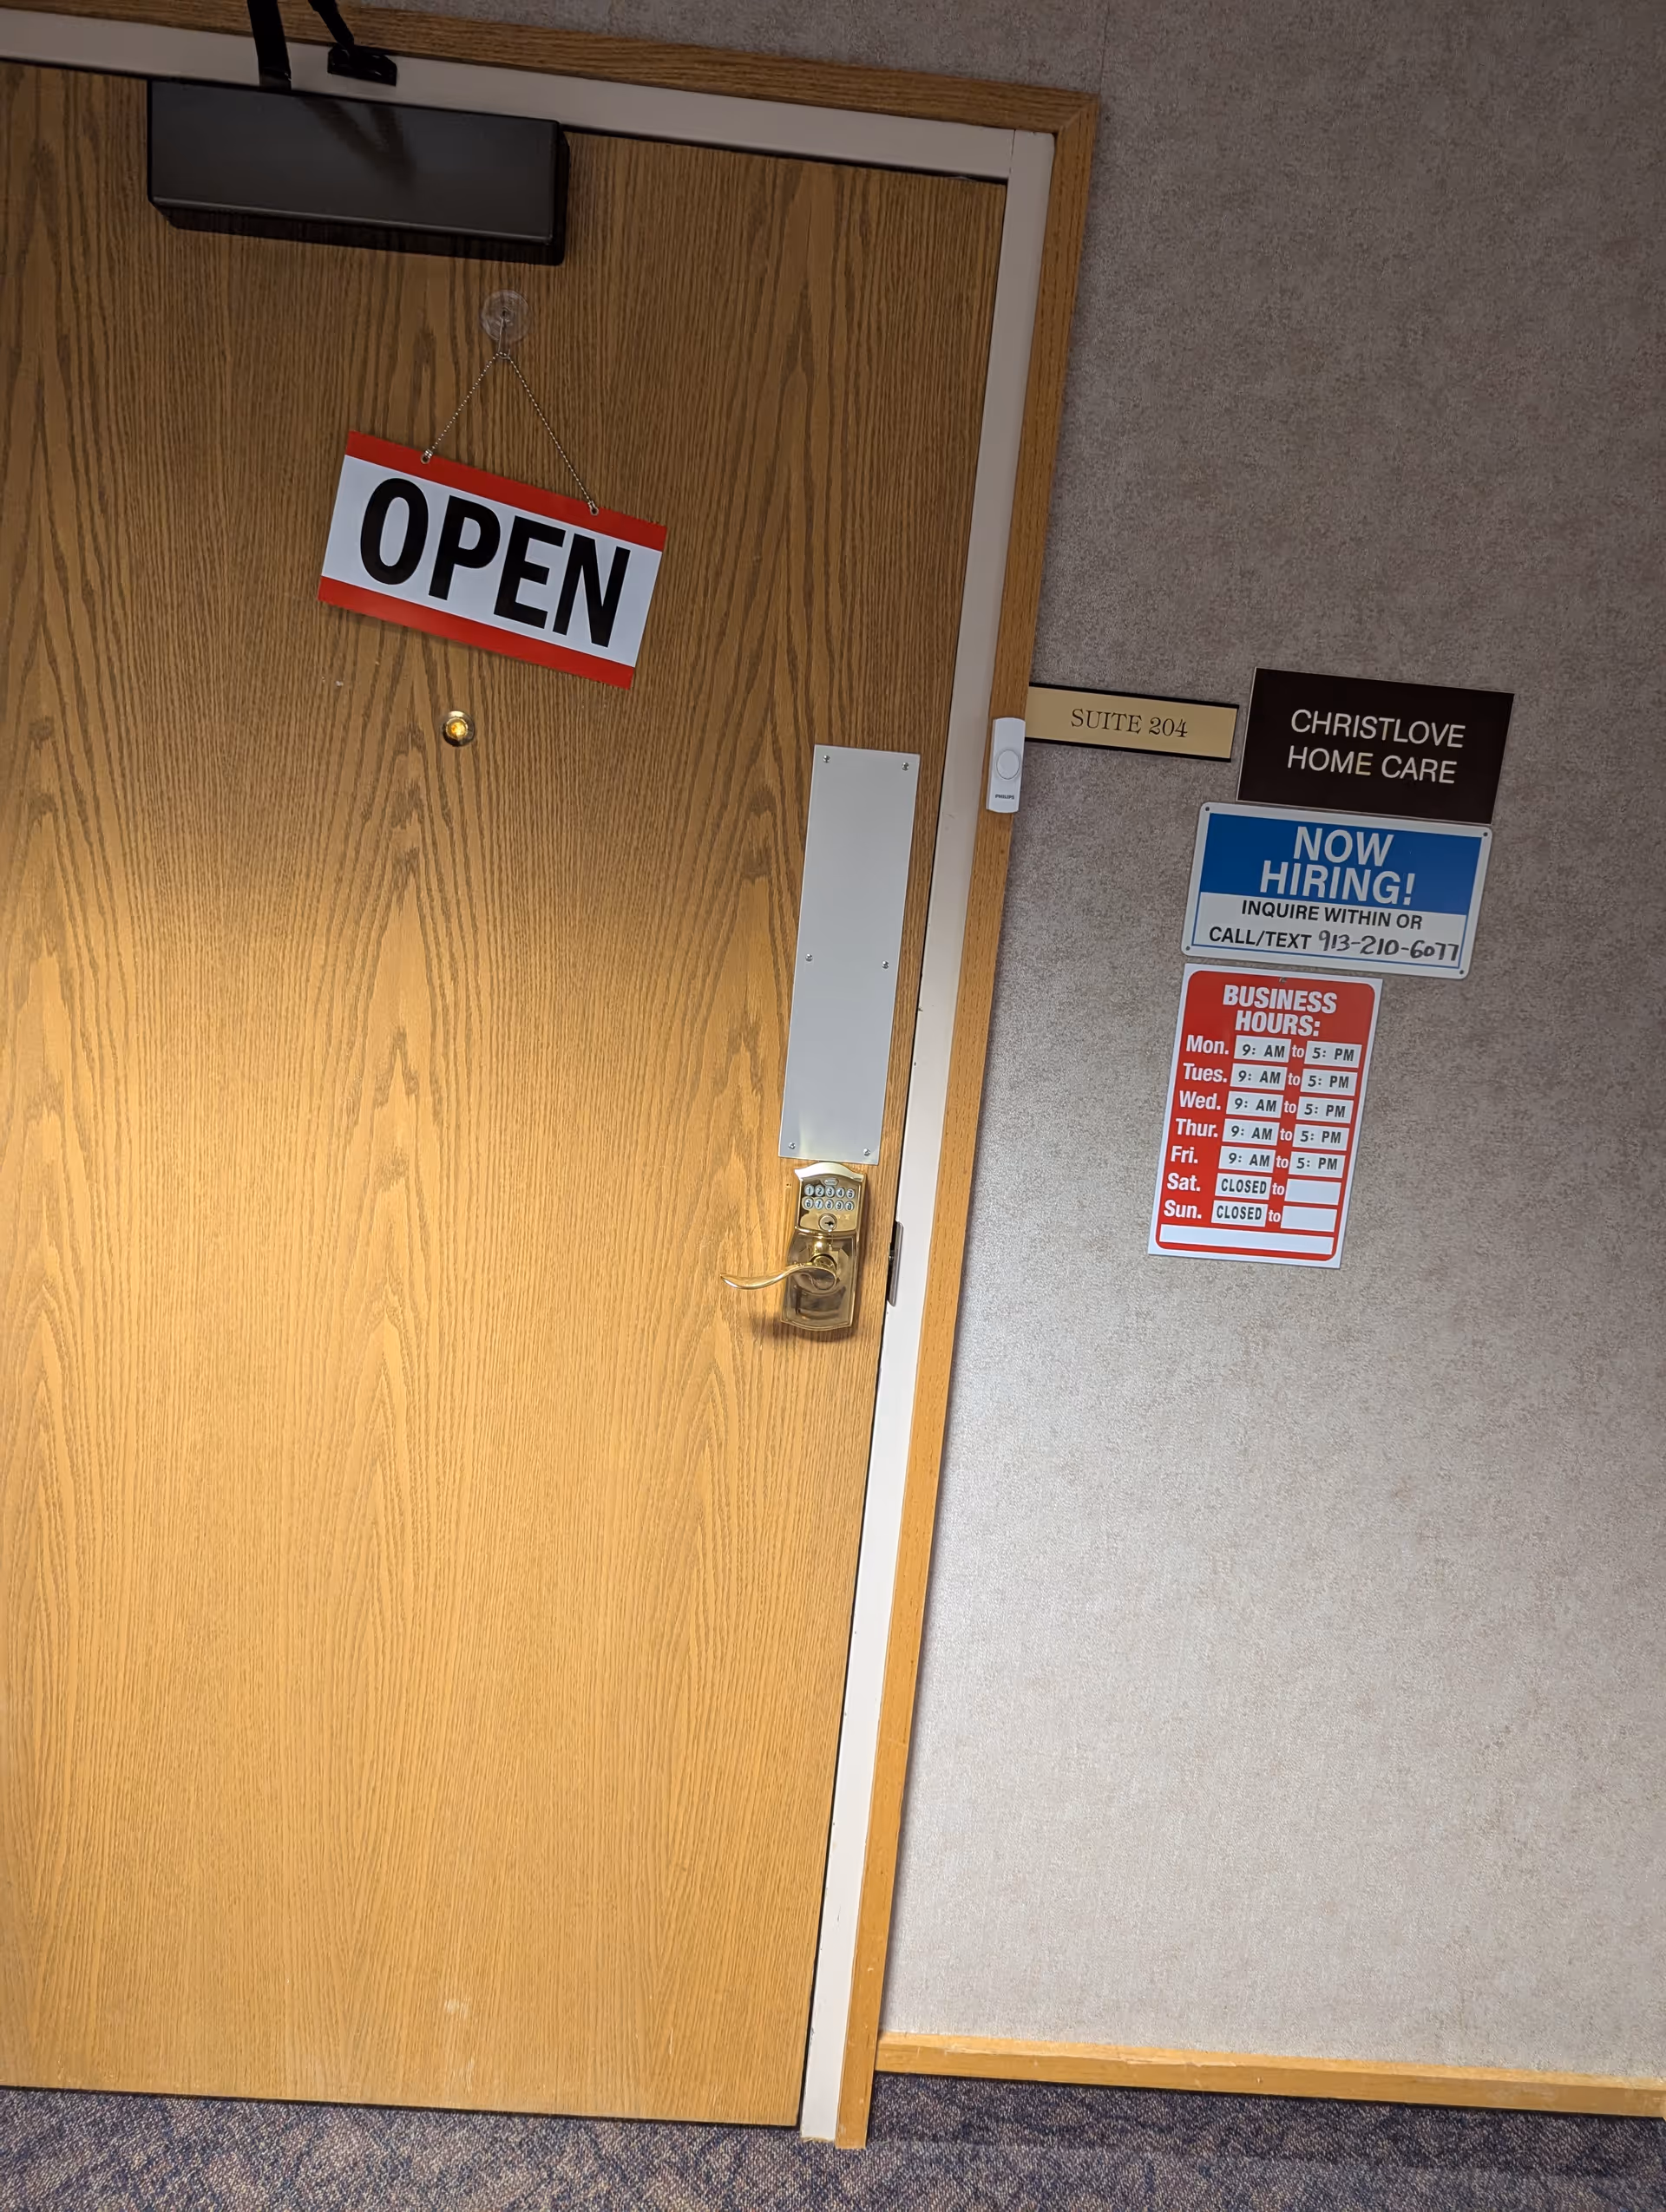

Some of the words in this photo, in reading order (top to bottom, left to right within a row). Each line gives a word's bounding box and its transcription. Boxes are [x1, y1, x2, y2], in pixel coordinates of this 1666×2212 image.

[360, 478, 631, 648] OPEN
[1071, 708, 1142, 734] SUITE
[1148, 717, 1188, 737] 204
[1291, 709, 1466, 748] CHRISTLOVE
[1288, 745, 1374, 776] HOME
[1381, 755, 1458, 784] CARE
[1293, 826, 1394, 867] NOW
[1260, 860, 1416, 906] HIRING!
[1242, 900, 1319, 920] INQUIRE
[1324, 907, 1391, 926] WITHIN
[1396, 914, 1423, 930] OR
[1209, 926, 1312, 950] CALL/TEXT
[1318, 930, 1459, 961] 913-210-6077
[1223, 984, 1337, 1014] BUSINESS
[1235, 1010, 1321, 1037] HOURS:
[1186, 1035, 1229, 1055] Mon.
[1243, 1044, 1256, 1056] 9:
[1264, 1045, 1285, 1058] AM
[1292, 1044, 1304, 1058] to
[1312, 1047, 1326, 1059] 5:
[1335, 1049, 1354, 1062] PM
[1183, 1063, 1227, 1083] Tues.
[1238, 1070, 1251, 1082] 9:
[1259, 1071, 1281, 1084] AM
[1288, 1072, 1301, 1086] to
[1308, 1075, 1322, 1087] 5:
[1329, 1076, 1349, 1089] PM
[1178, 1091, 1221, 1110] Wed.
[1234, 1098, 1248, 1109] 9:
[1256, 1099, 1276, 1112] AM
[1284, 1100, 1296, 1114] to
[1304, 1103, 1318, 1116] 5:
[1326, 1104, 1346, 1118] PM
[1176, 1118, 1218, 1137] Thur.
[1230, 1126, 1244, 1137] 9:
[1252, 1128, 1273, 1141] AM
[1280, 1128, 1292, 1142] to
[1300, 1130, 1314, 1142] 5:
[1322, 1132, 1341, 1144] PM
[1171, 1146, 1198, 1163] Fri.
[1228, 1153, 1242, 1165] 9:
[1250, 1155, 1270, 1168] AM
[1276, 1155, 1289, 1168] to
[1296, 1158, 1311, 1169] 5:
[1318, 1158, 1337, 1170] PM
[1167, 1173, 1200, 1192] Sat.
[1221, 1178, 1267, 1194] CLOSED
[1272, 1182, 1285, 1196] to
[1164, 1200, 1202, 1219] Sun.
[1217, 1205, 1263, 1221] CLOSED
[1269, 1210, 1281, 1222] to
